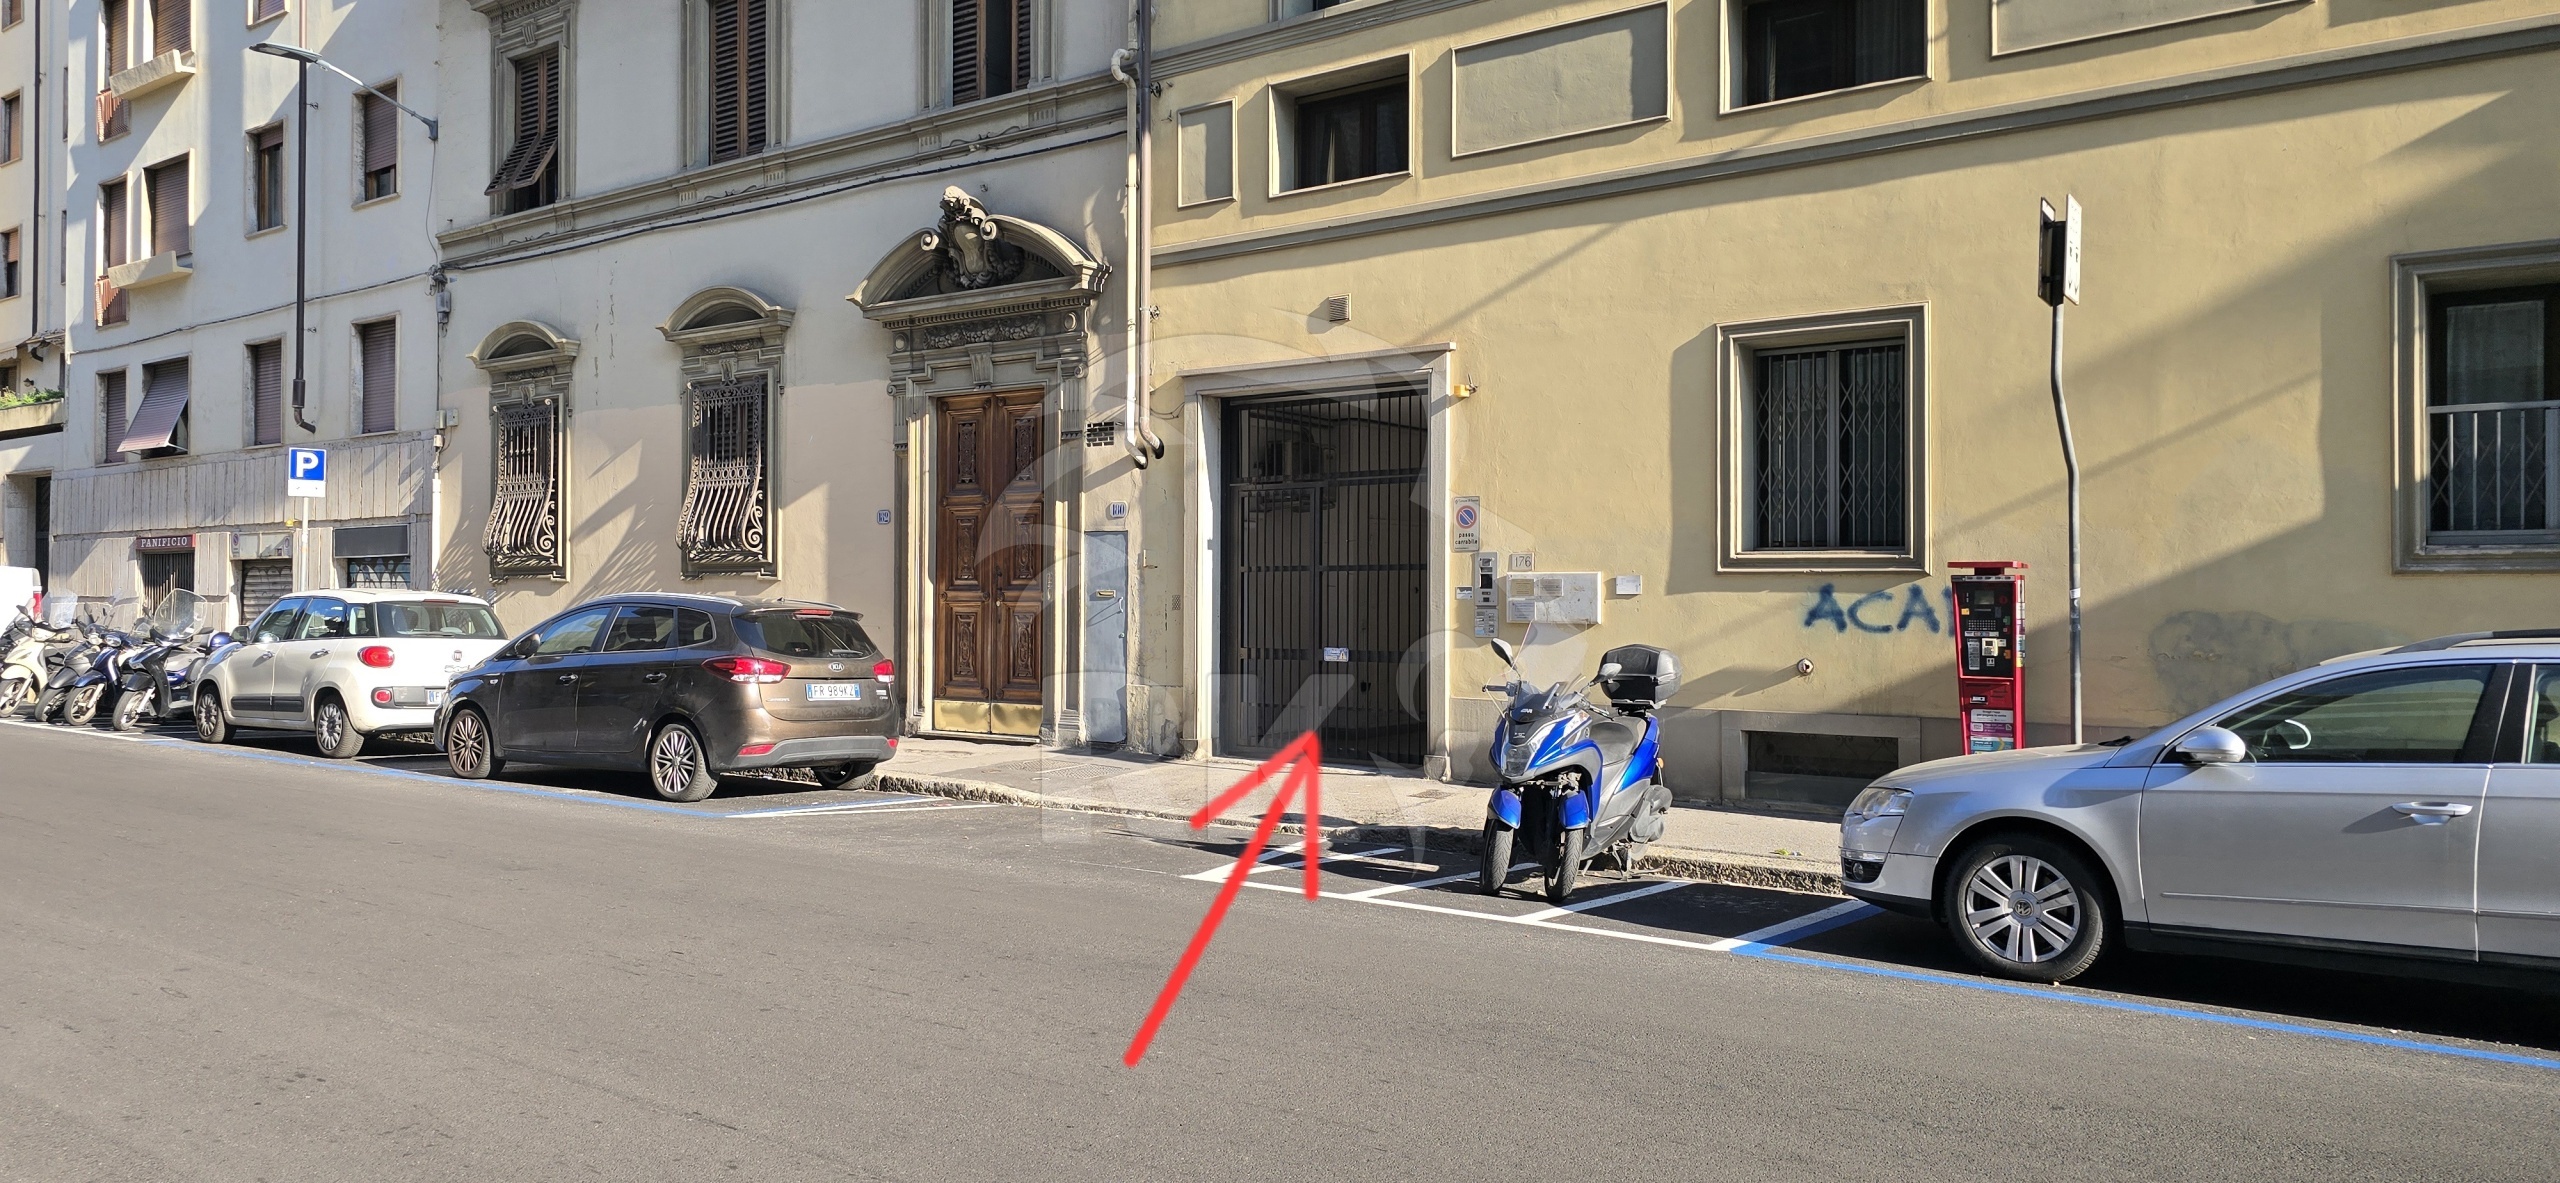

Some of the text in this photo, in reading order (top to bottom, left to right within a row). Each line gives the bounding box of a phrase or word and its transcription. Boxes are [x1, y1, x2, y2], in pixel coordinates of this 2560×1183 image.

[296, 451, 319, 478] P
[141, 537, 188, 548] PANIFICIO
[1515, 556, 1532, 568] 176
[813, 685, 854, 696] FR 989KZ
